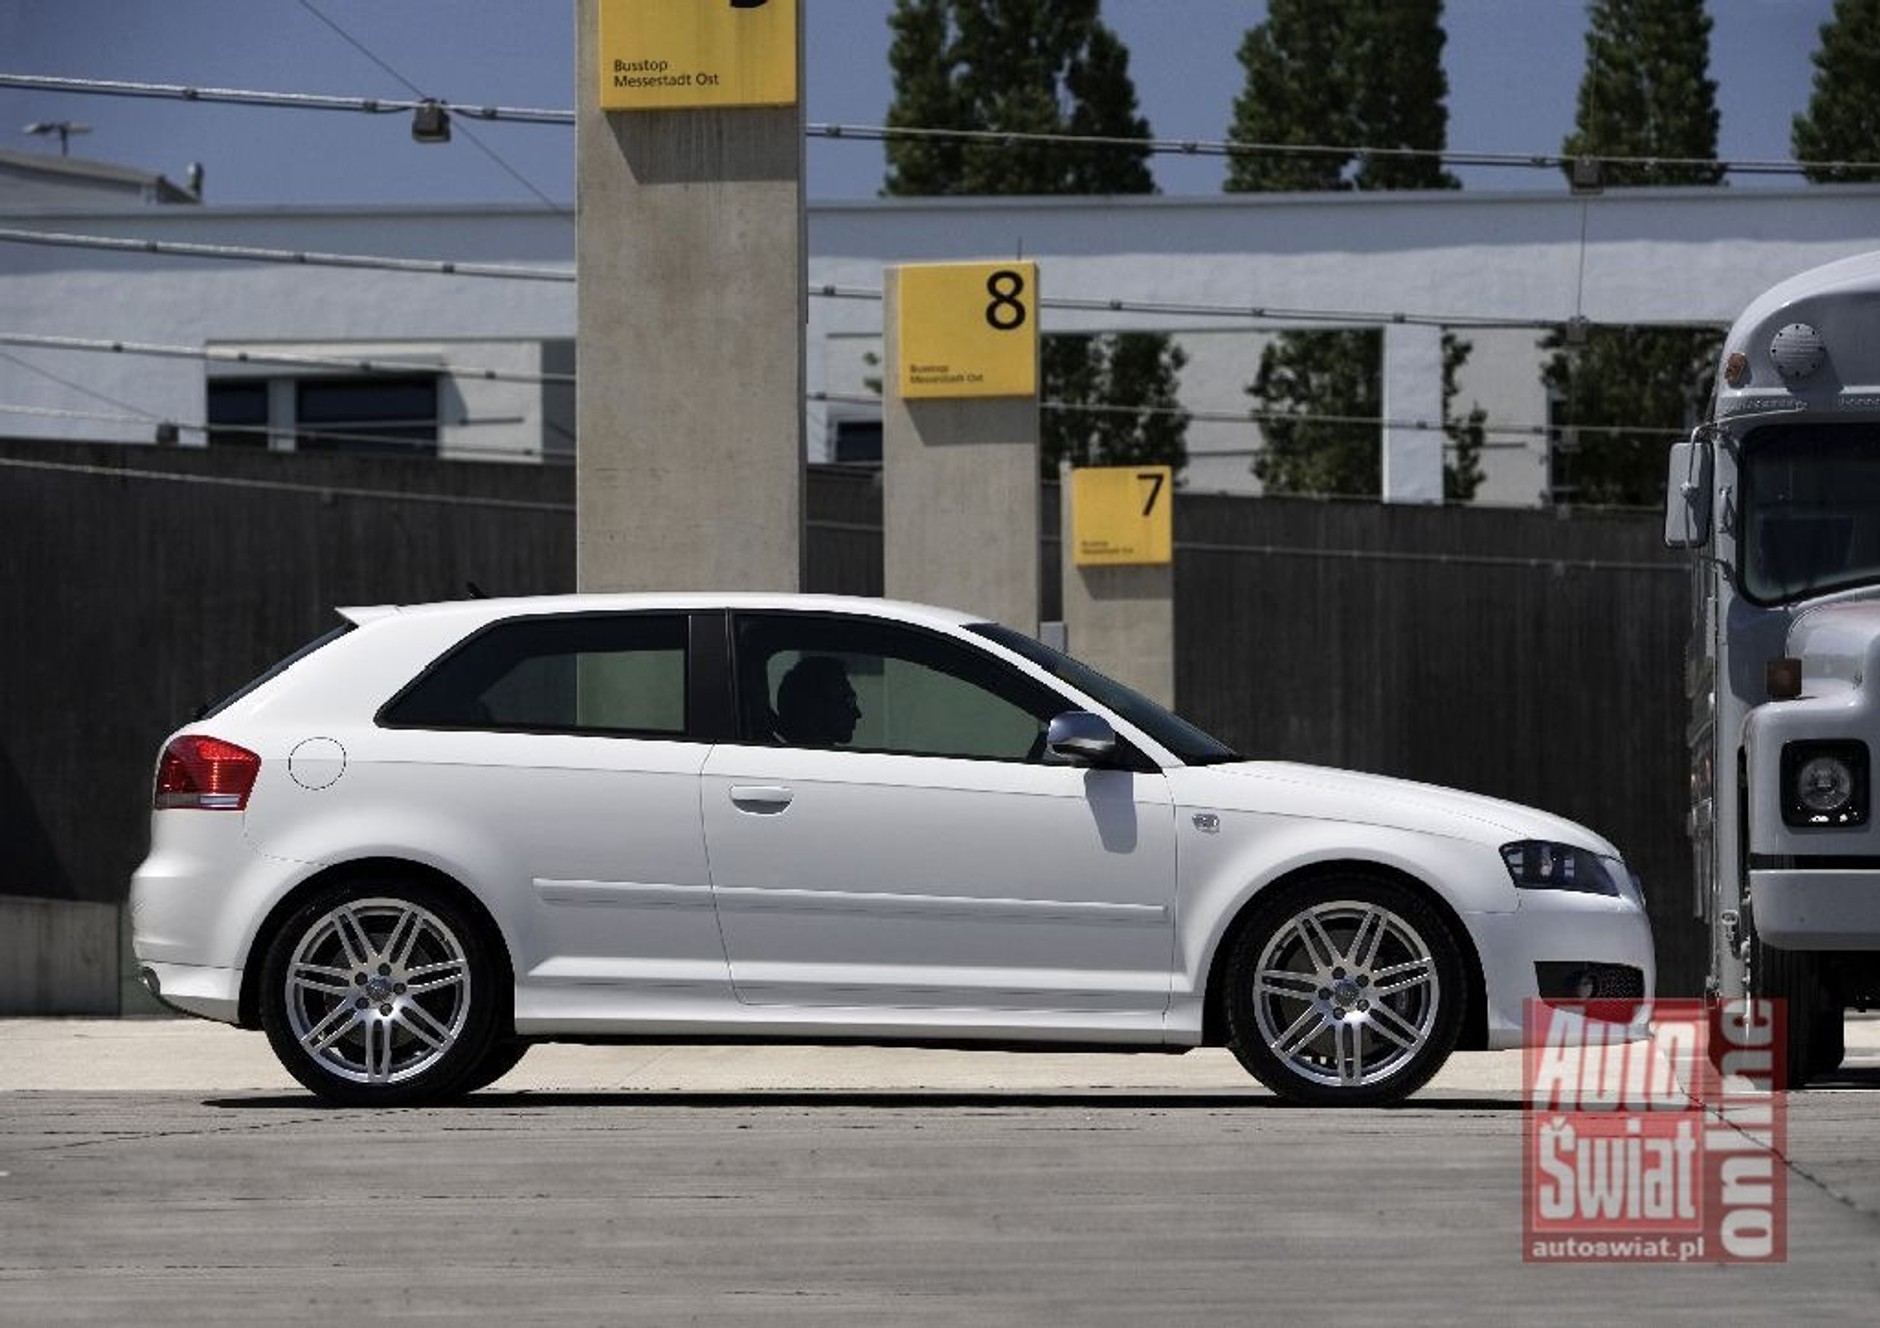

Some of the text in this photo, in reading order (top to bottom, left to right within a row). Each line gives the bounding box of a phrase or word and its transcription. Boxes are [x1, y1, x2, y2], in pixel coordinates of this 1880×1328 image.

[613, 59, 668, 72] Busstop
[613, 73, 719, 87] Messestadt Ost
[986, 270, 1026, 330] 8
[1137, 474, 1164, 516] 7
